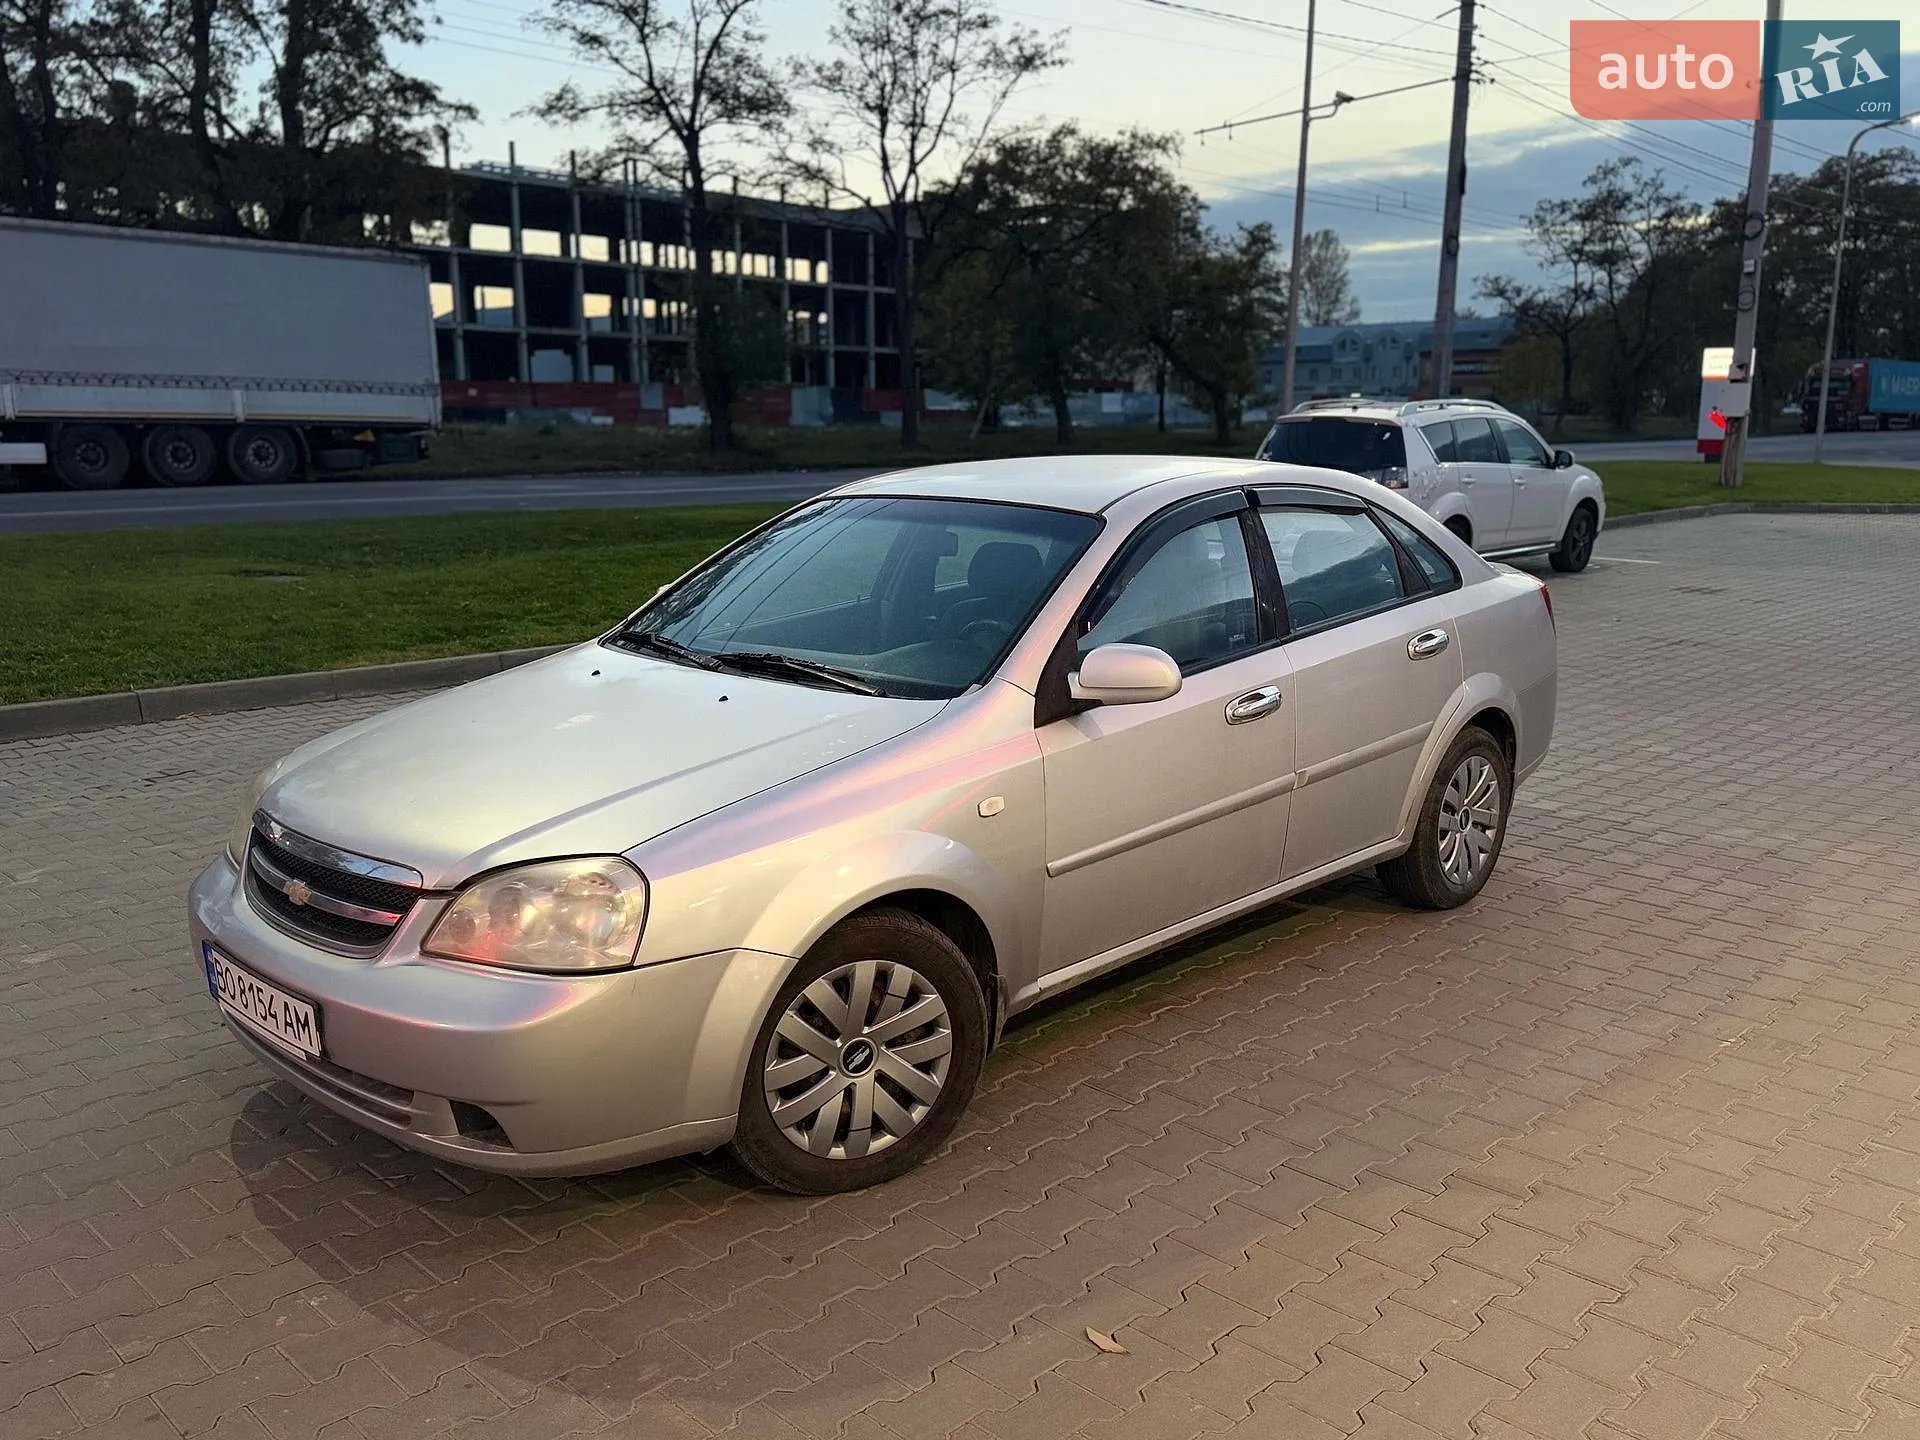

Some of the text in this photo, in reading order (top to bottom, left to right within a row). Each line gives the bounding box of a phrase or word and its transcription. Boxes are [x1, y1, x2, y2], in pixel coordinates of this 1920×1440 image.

[214, 957, 314, 1048] BO 8154 AM
